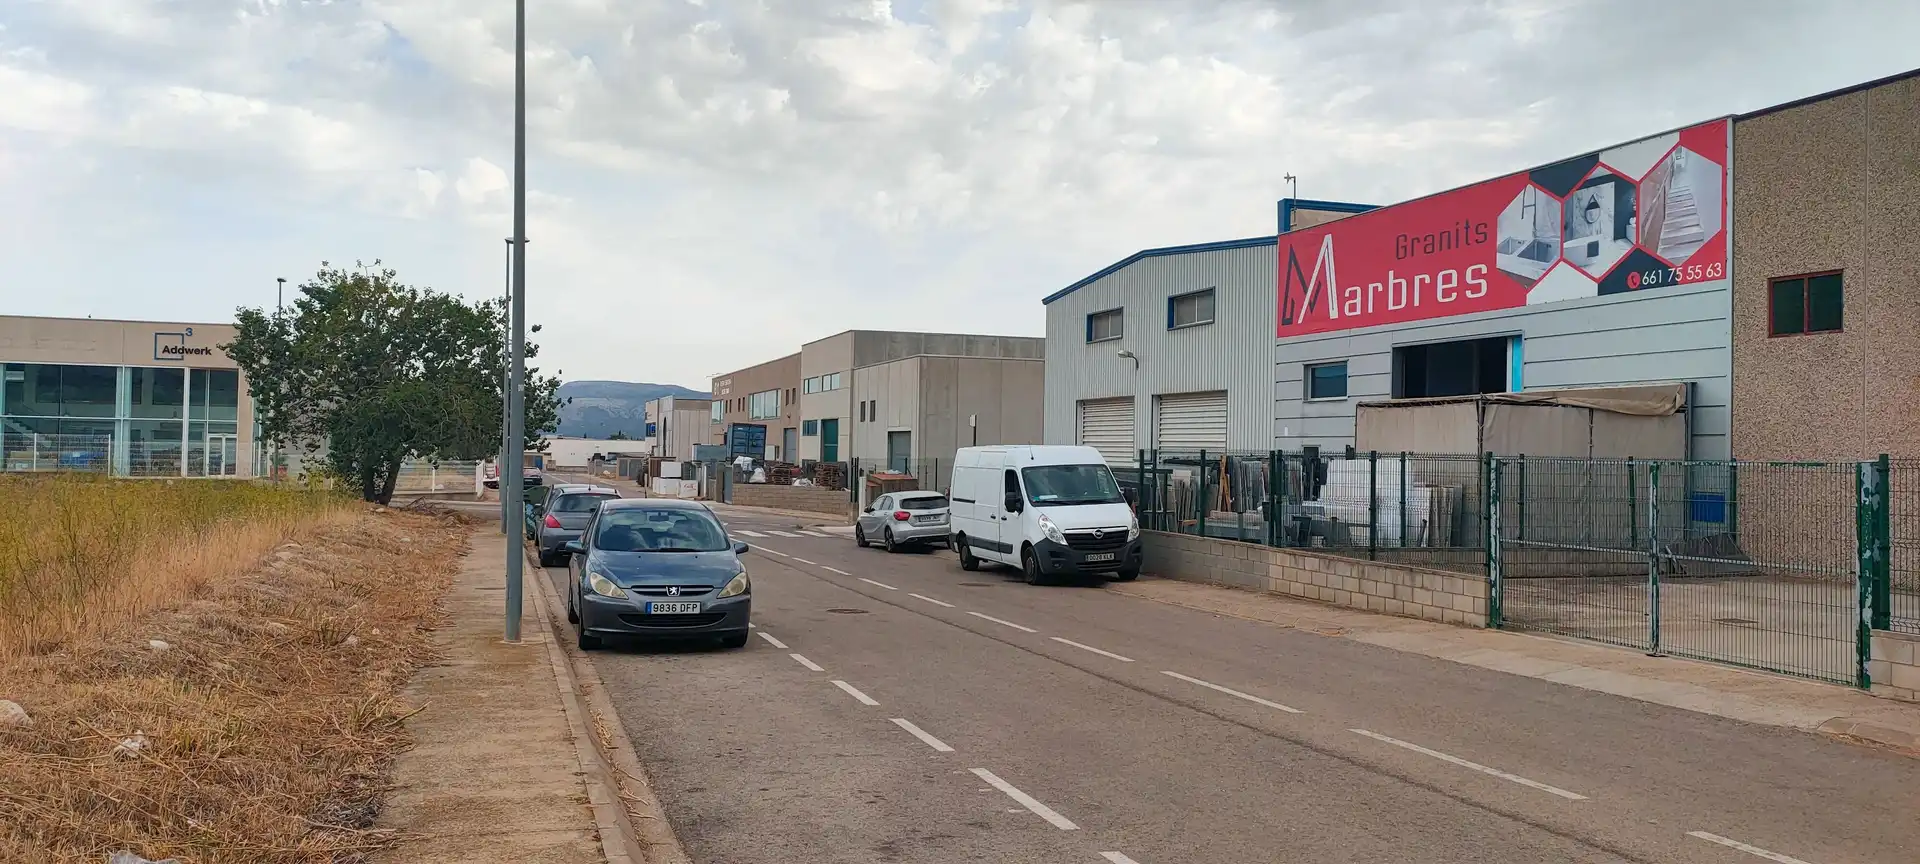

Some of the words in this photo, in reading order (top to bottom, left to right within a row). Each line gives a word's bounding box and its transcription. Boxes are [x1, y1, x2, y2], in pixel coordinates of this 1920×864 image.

[1395, 219, 1488, 260] Granits
[1281, 233, 1488, 326] Marbres
[1642, 269, 1662, 285] 661
[1667, 267, 1683, 283] 75
[1686, 264, 1702, 281] 55
[1706, 262, 1722, 278] 63
[162, 345, 212, 356] Addwerk
[653, 603, 677, 612] 9836
[680, 603, 698, 612] DFP
